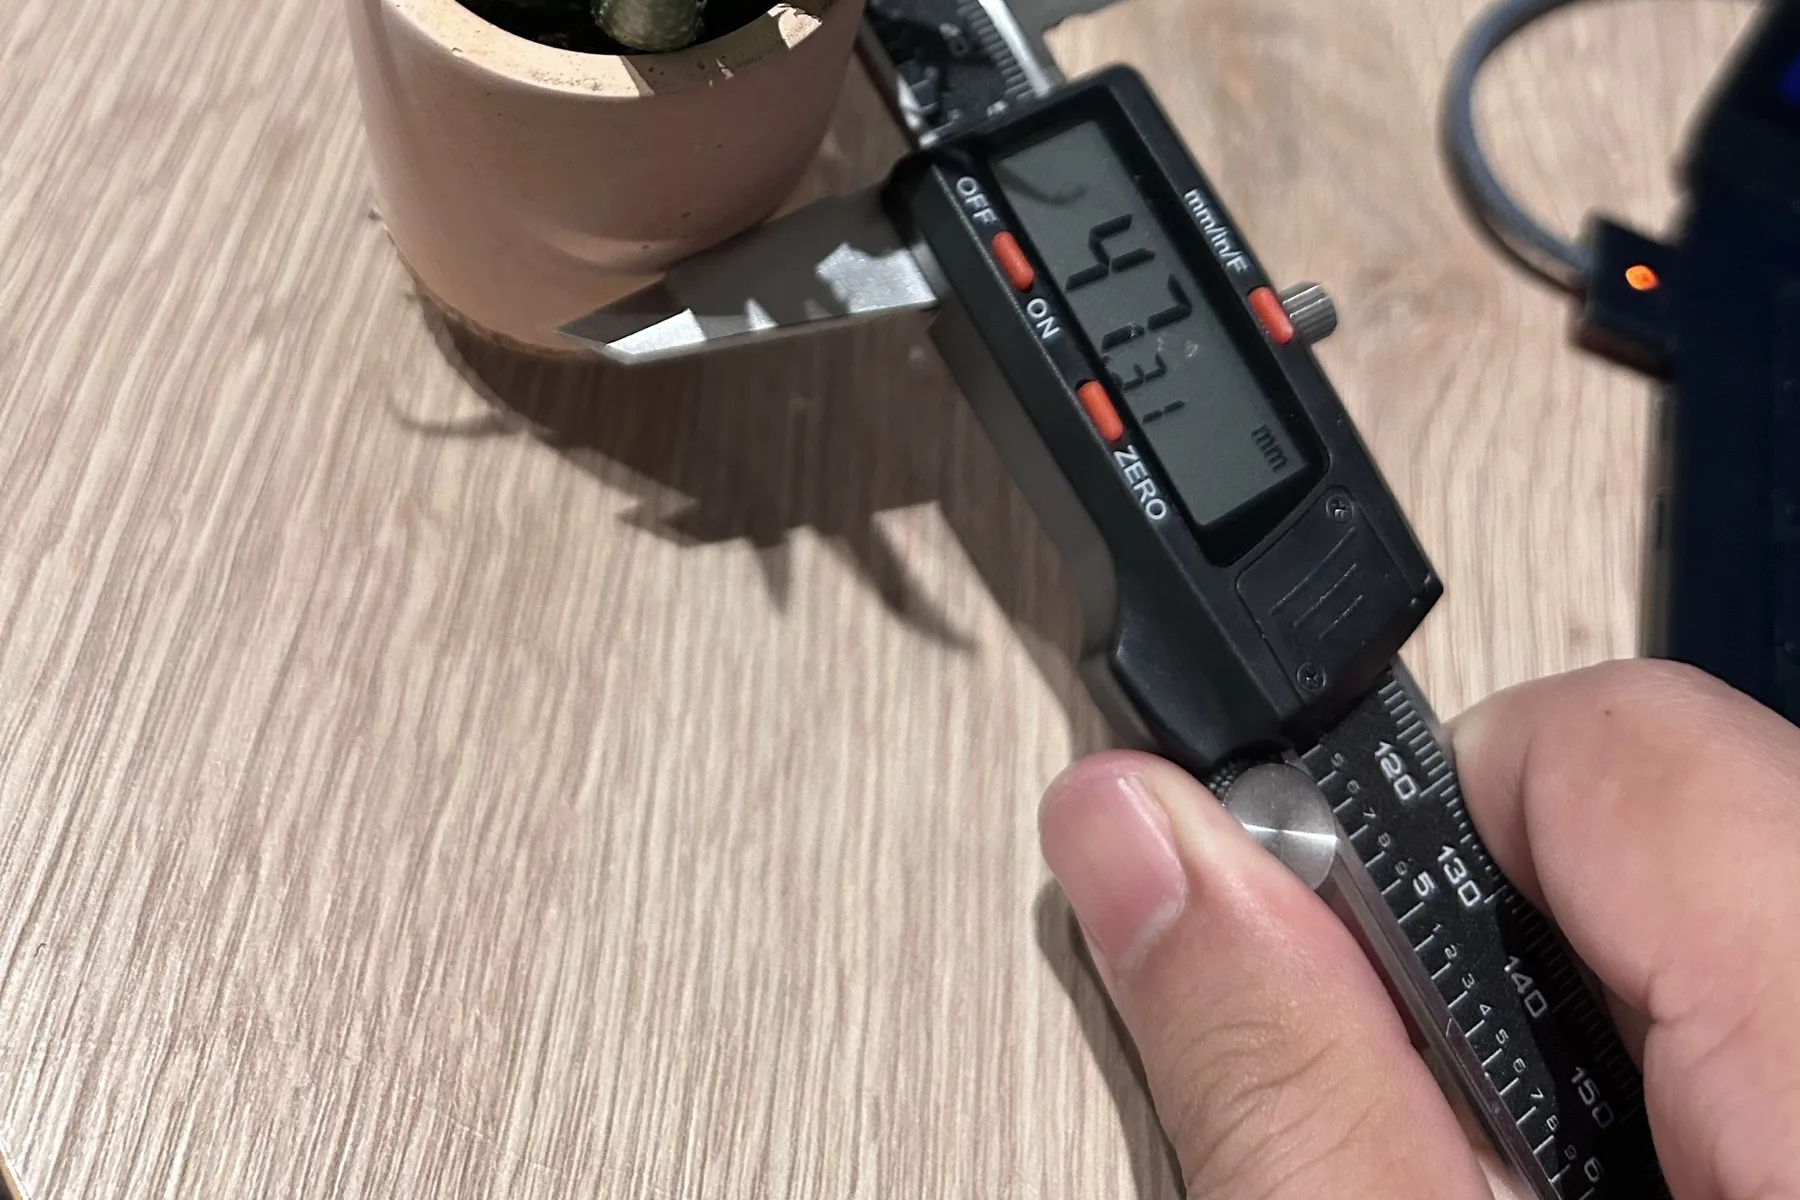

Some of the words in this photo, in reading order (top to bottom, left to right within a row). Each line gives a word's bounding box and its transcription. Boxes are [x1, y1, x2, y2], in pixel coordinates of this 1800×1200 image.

[955, 175, 999, 227] OFF
[1026, 297, 1061, 341] ON
[1251, 424, 1288, 474] mm
[1113, 445, 1167, 522] ZERO
[1374, 741, 1418, 800] 120
[1437, 845, 1482, 907] 130
[1504, 955, 1548, 1018] 140
[1571, 1066, 1615, 1129] 150
[1363, 806, 1377, 819] 7
[1377, 832, 1392, 847] 8
[1412, 870, 1436, 897] 5
[1444, 944, 1458, 959] 2
[1461, 972, 1476, 989] 3
[1479, 1003, 1492, 1016] 4
[1495, 1028, 1509, 1045] 5
[1512, 1057, 1527, 1074] 6
[1530, 1086, 1544, 1100] 7
[1546, 1114, 1560, 1131] 8
[1583, 1155, 1604, 1183] 6
